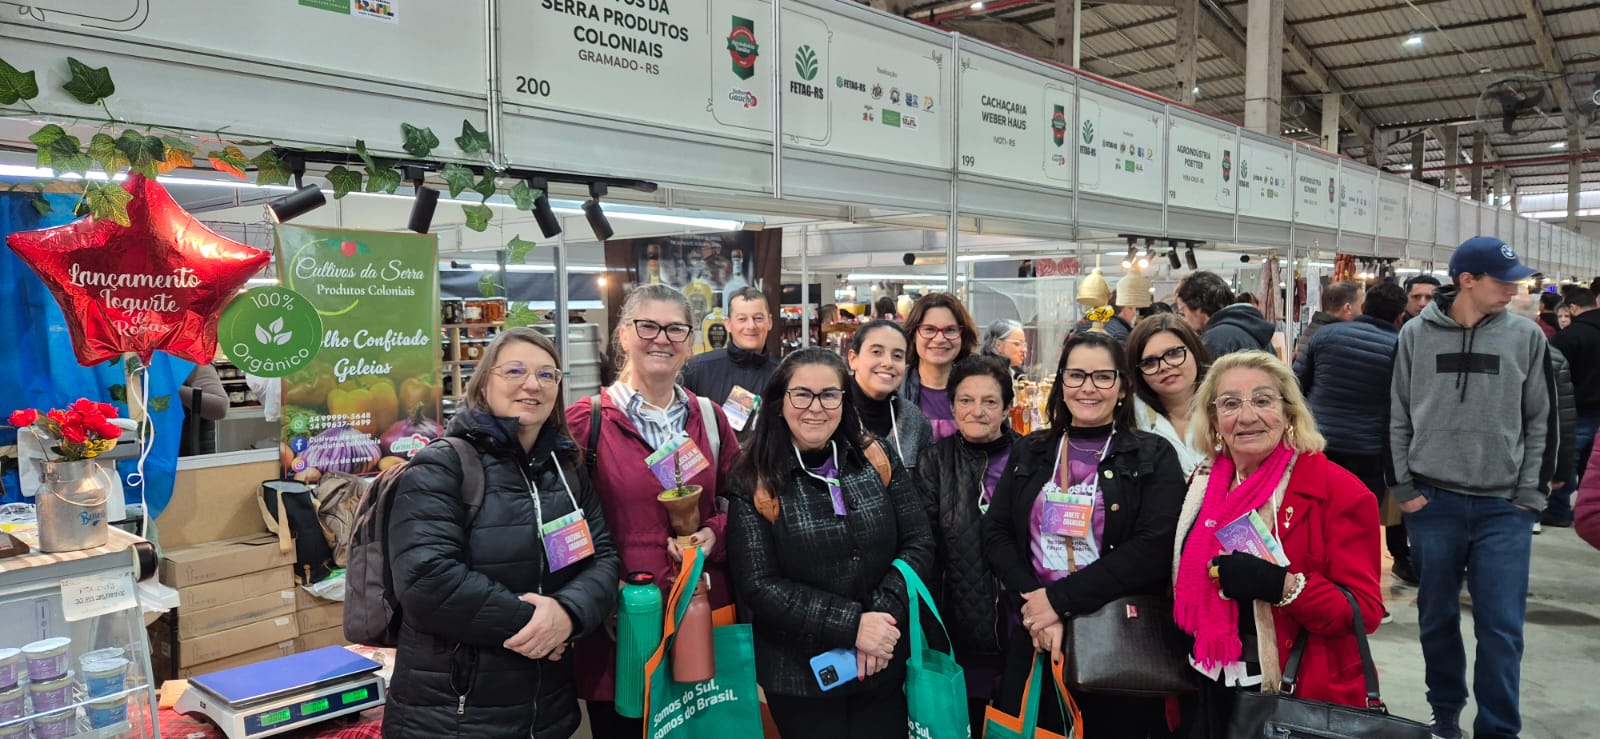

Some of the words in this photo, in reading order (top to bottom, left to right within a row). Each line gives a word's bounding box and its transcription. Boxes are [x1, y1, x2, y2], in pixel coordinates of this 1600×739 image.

[541, 0, 600, 21] SERRA
[604, 8, 689, 42] PRODUTOS
[573, 25, 663, 58] COLONIAIS
[578, 49, 638, 71] GRAMADO
[645, 63, 660, 75] RS
[516, 76, 551, 97] 200
[789, 80, 824, 100] FETAG-RS
[981, 95, 1027, 115] CACHAÇARIA
[981, 111, 1007, 126] WEBER
[1007, 117, 1027, 130] HAUS
[962, 155, 975, 167] 199
[68, 263, 201, 291] Lançamento
[295, 256, 356, 279] Cultivos
[360, 262, 377, 279] da
[381, 259, 424, 281] Serra
[250, 292, 295, 311] 100%
[317, 283, 365, 296] Produtos
[368, 284, 415, 297] Coloniais
[100, 289, 180, 317] Iogurte
[112, 320, 170, 337] Rosas
[320, 330, 351, 349] lho
[353, 329, 431, 352] Confitado
[233, 343, 309, 373] Orgânico
[333, 358, 392, 382] Geleias
[653, 699, 682, 727] Somos
[683, 690, 694, 704] do
[695, 678, 719, 696] Sul,
[654, 714, 684, 739] somos
[685, 705, 696, 719] do
[697, 689, 738, 710] Brasil.
